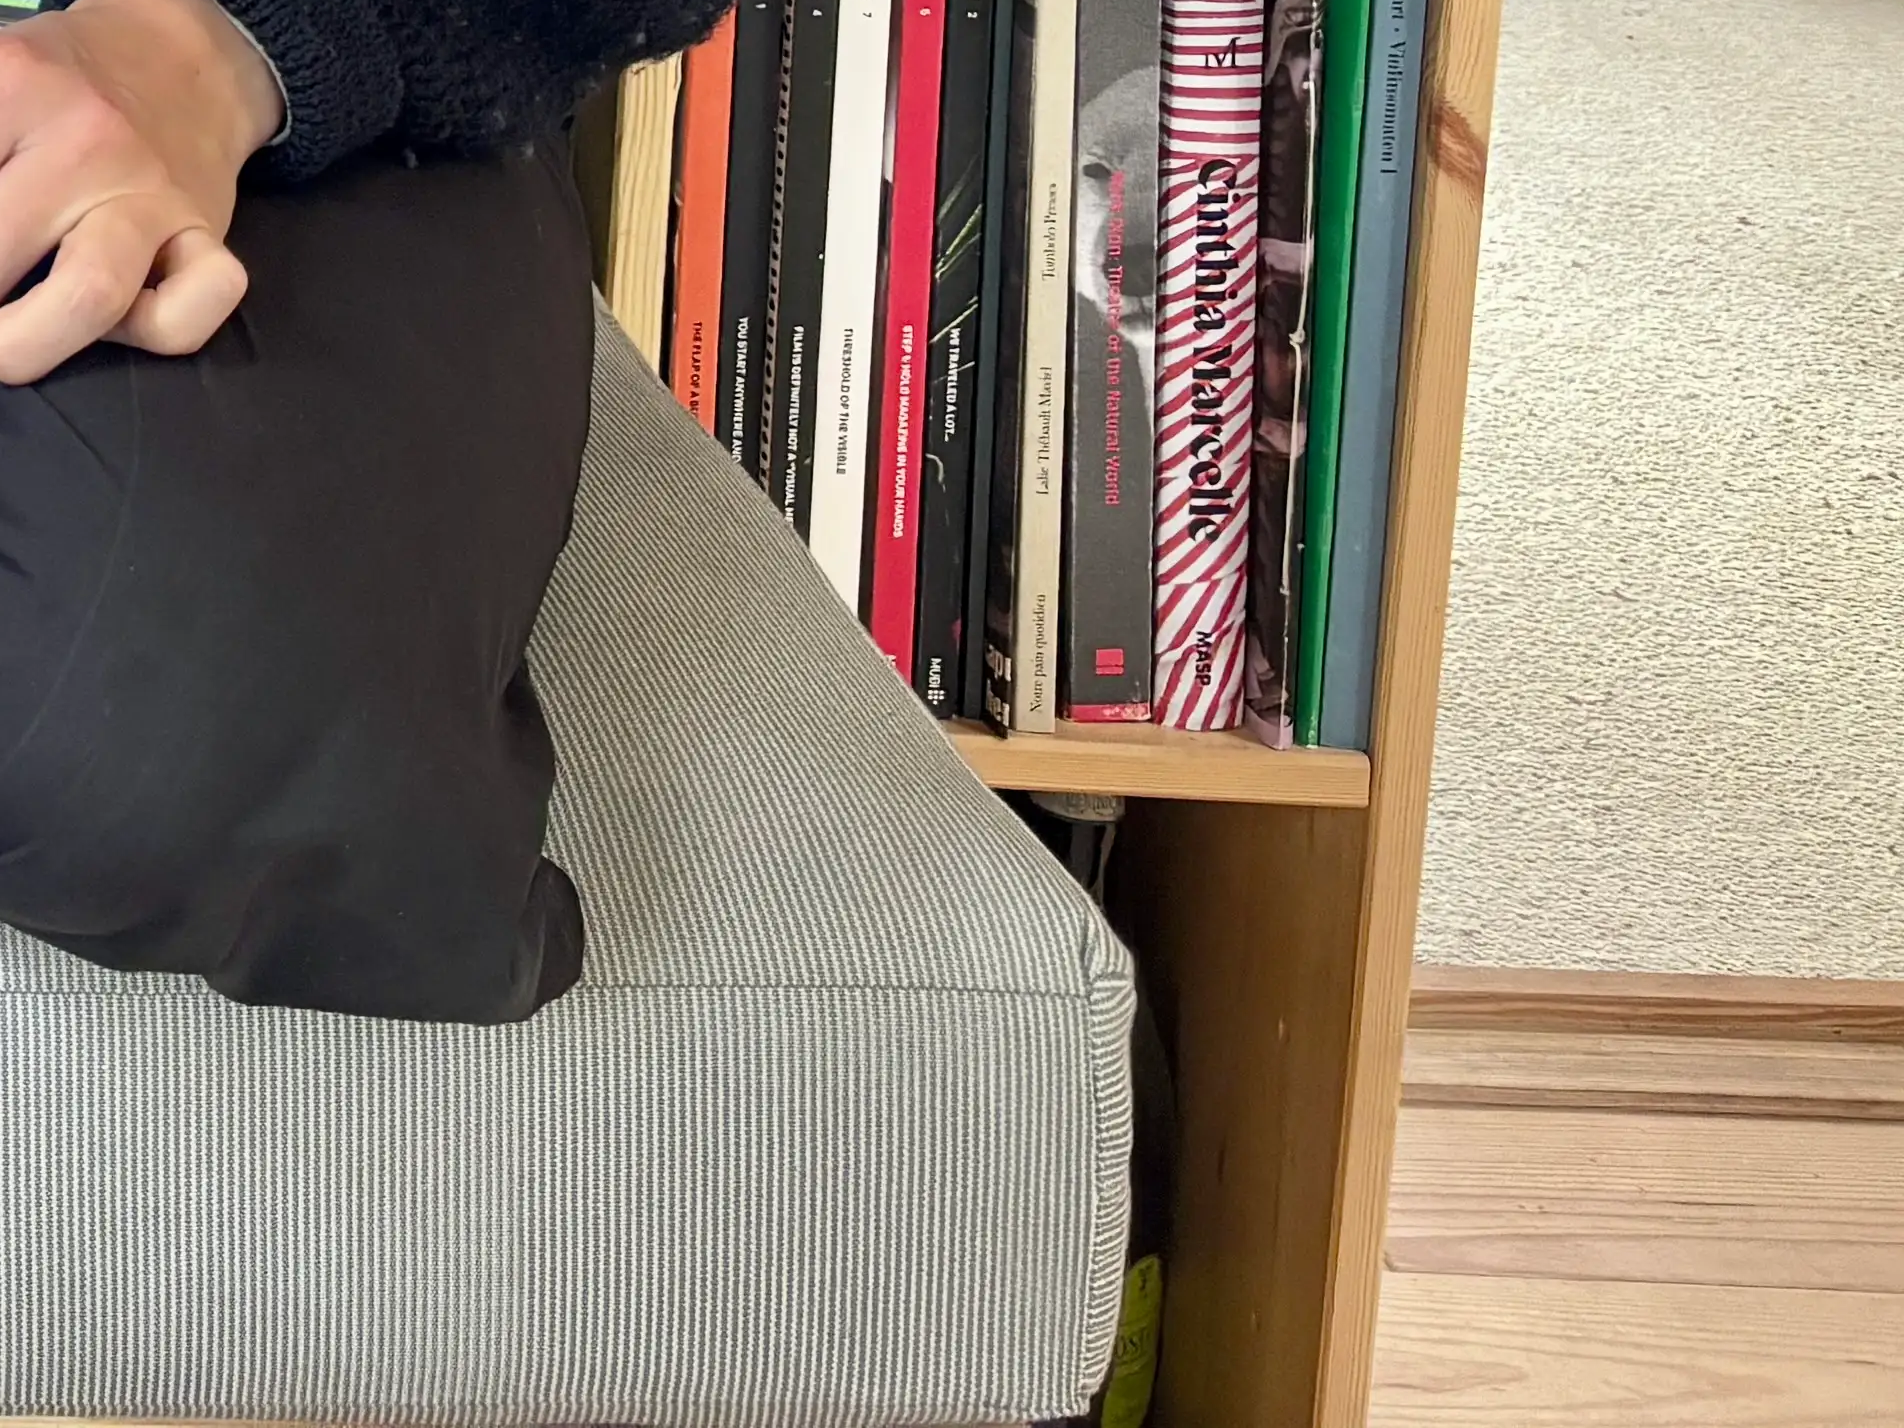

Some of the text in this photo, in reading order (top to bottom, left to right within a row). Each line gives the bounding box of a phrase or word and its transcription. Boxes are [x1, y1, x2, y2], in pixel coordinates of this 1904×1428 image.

[812, 9, 823, 17] 4
[1187, 159, 1241, 543] Cinthia Marcelle
[1193, 631, 1213, 686] MASP
